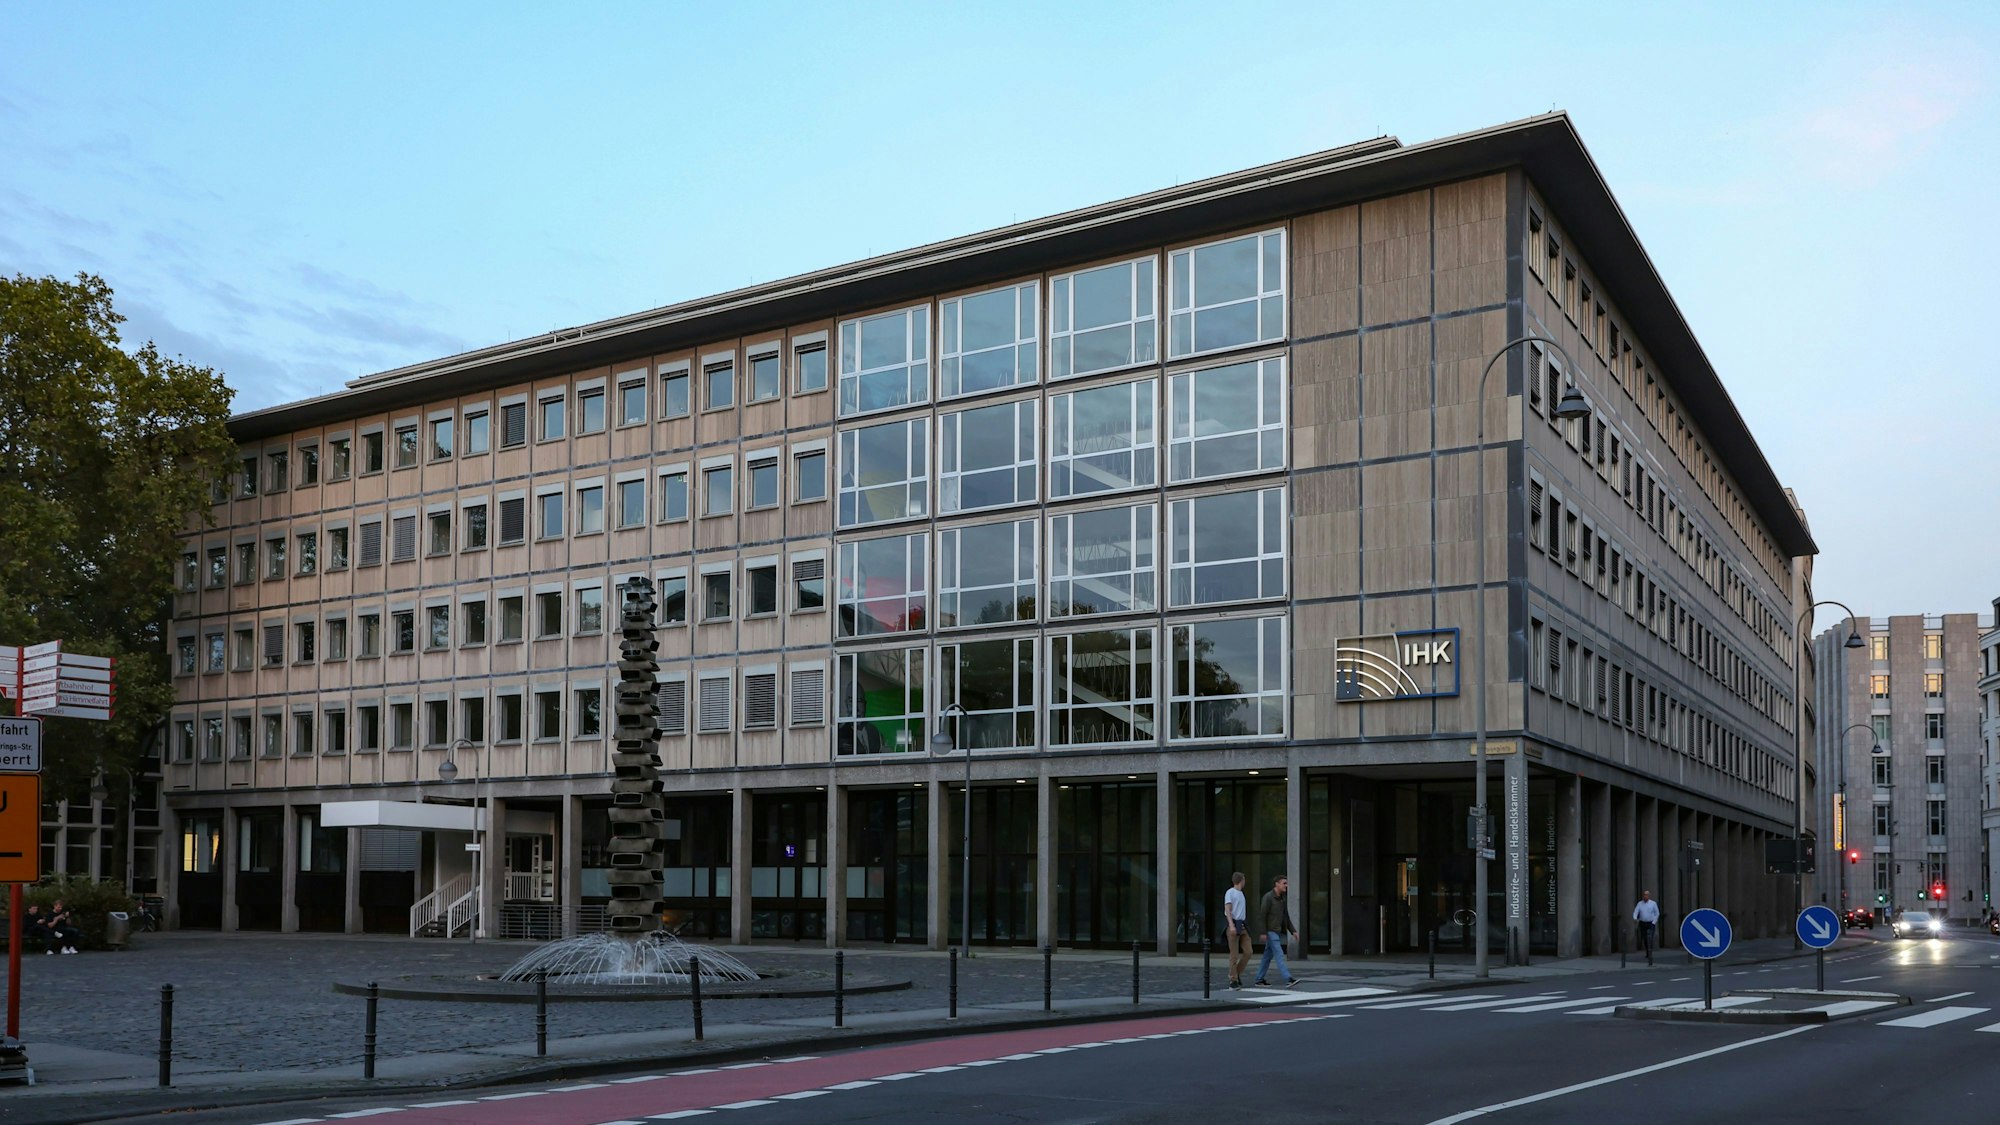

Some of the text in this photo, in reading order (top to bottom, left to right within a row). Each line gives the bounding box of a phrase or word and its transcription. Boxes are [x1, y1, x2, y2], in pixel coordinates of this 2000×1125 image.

[1404, 640, 1451, 665] IHK
[1509, 776, 1520, 918] Industrie- und Handelskammer
[1546, 857, 1556, 872] und
[1547, 875, 1556, 915] Industrie-
